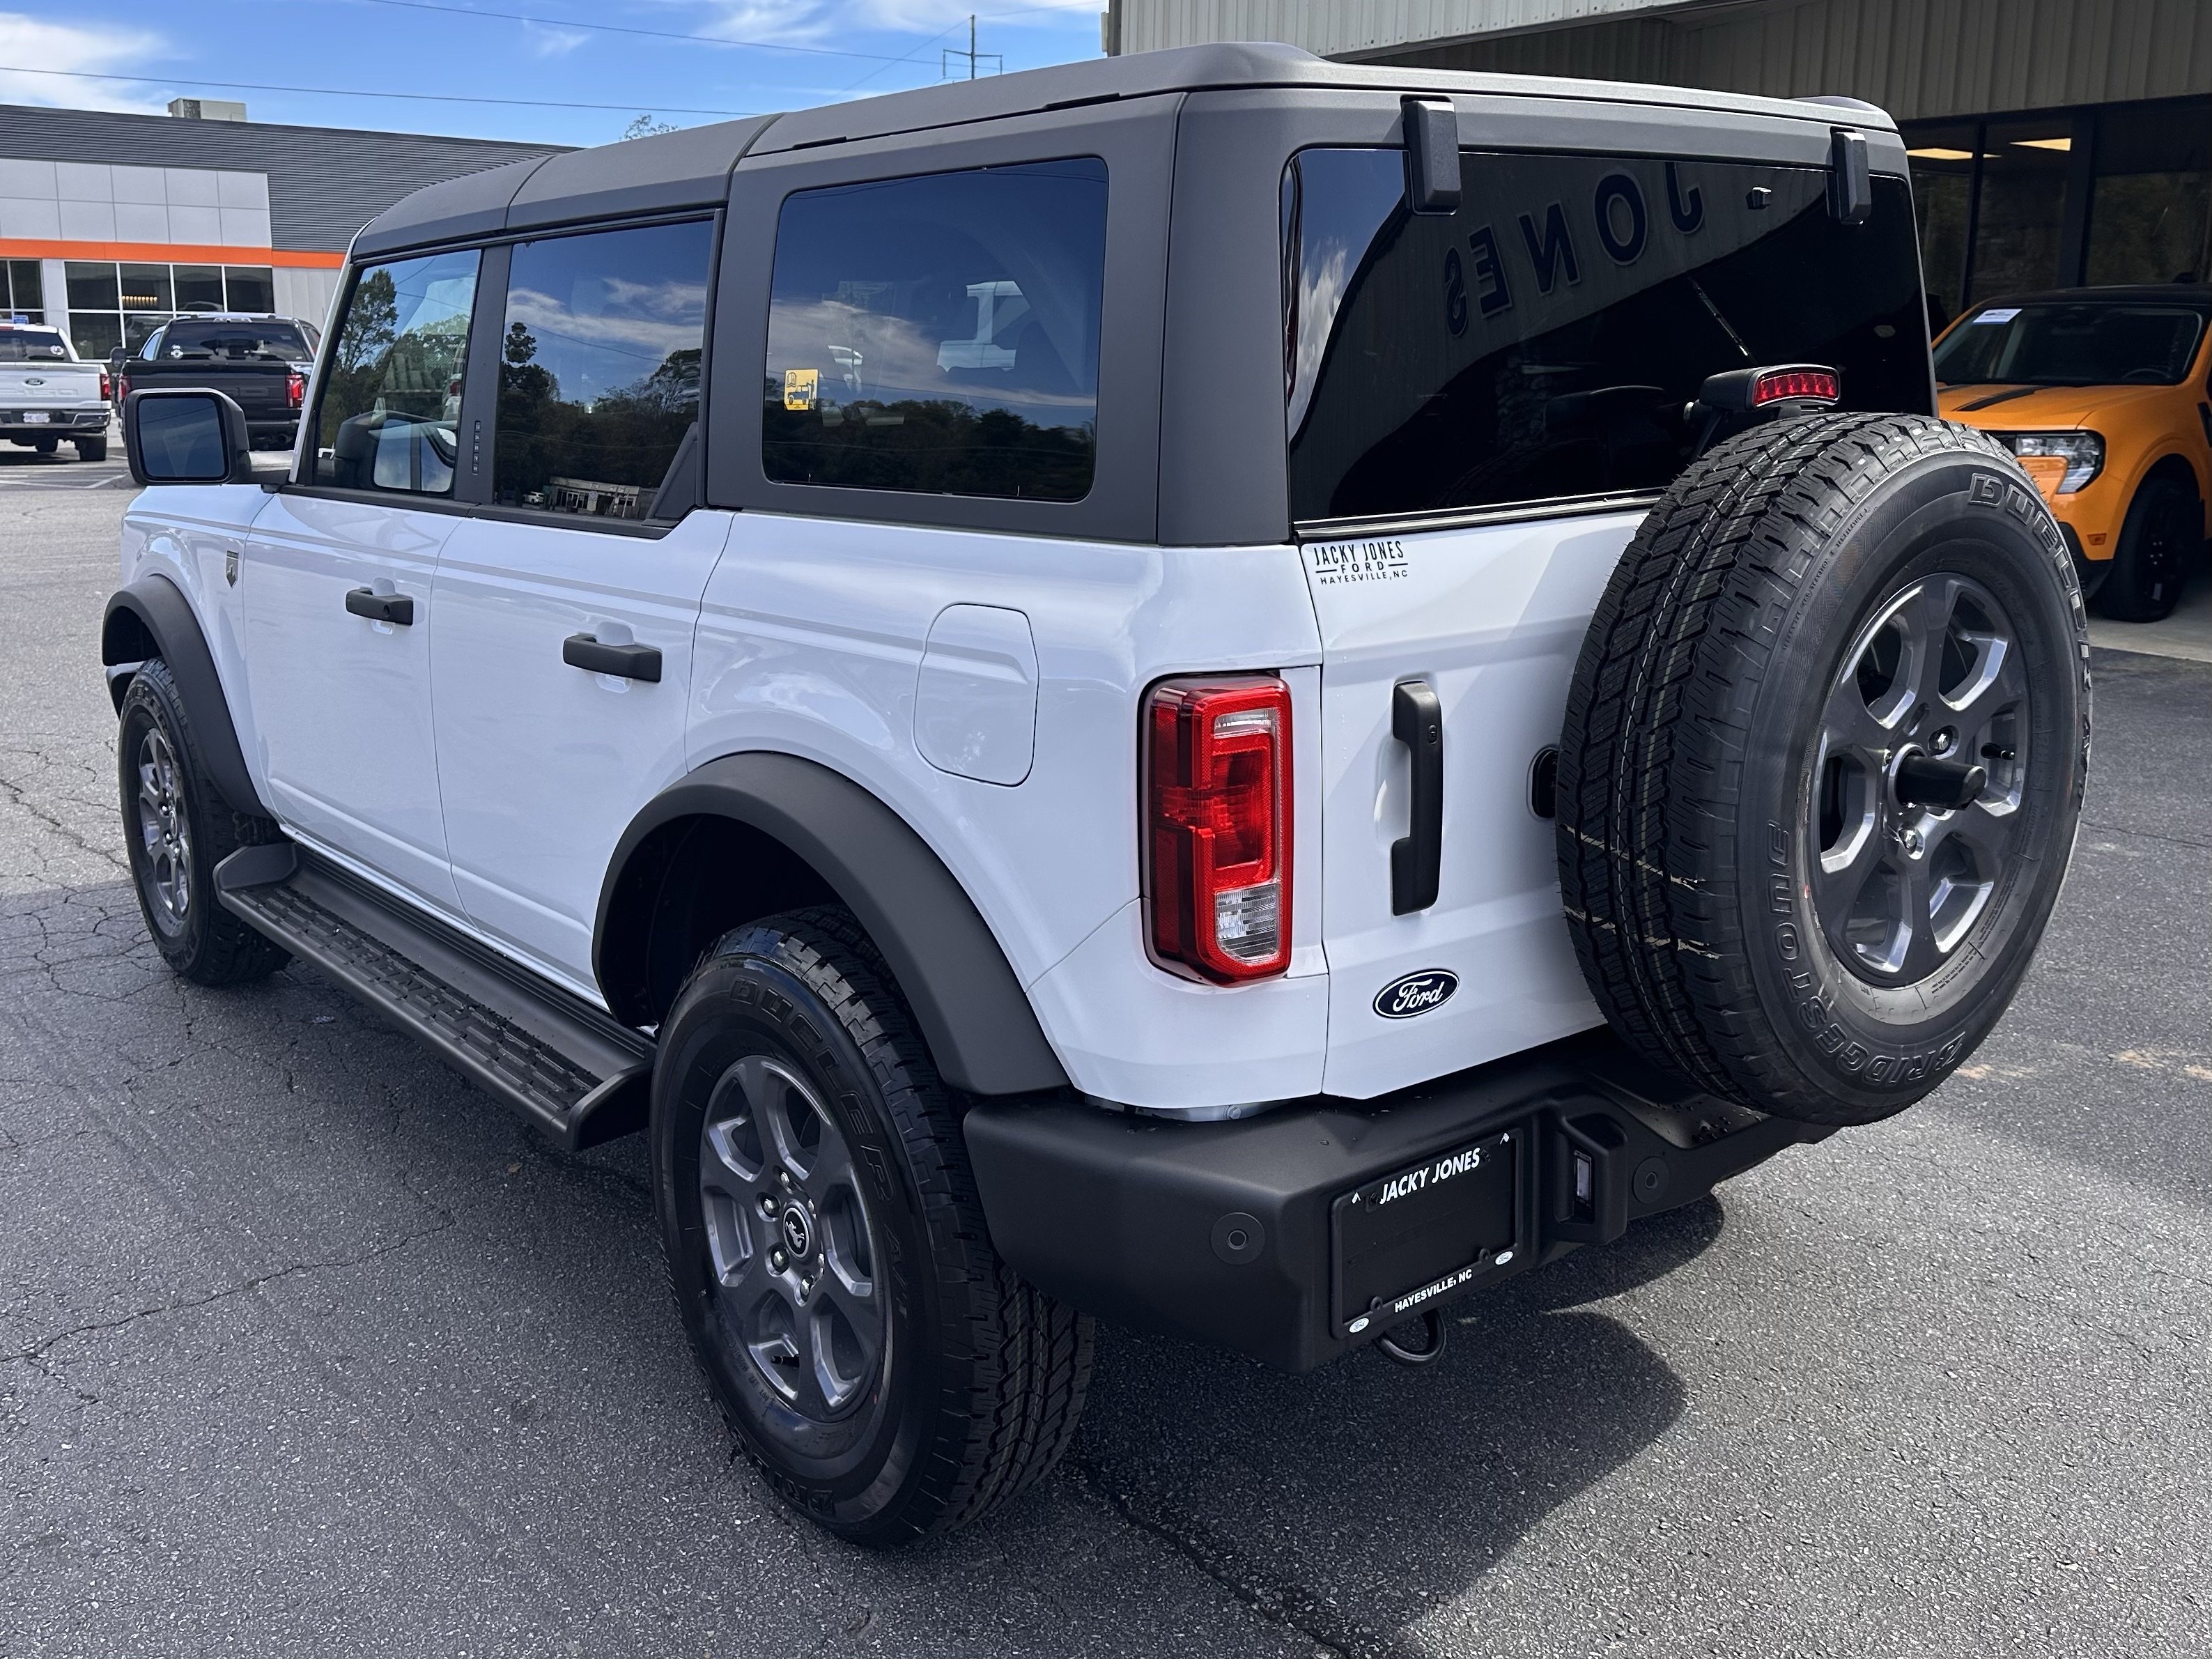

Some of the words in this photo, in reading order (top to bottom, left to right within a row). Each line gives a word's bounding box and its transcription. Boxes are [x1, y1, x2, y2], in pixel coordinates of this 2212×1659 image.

[1313, 544, 1356, 566] JACKY
[1362, 540, 1404, 561] JONES
[1340, 561, 1384, 573] FORD
[1767, 819, 1966, 1086] BRIDGESTONE
[730, 977, 897, 1203] DUELER
[1379, 1167, 1430, 1205] JACKY
[1432, 1147, 1481, 1184] JONES
[1395, 1276, 1457, 1313] HAYESVILLE,
[1458, 1269, 1472, 1284] NC
